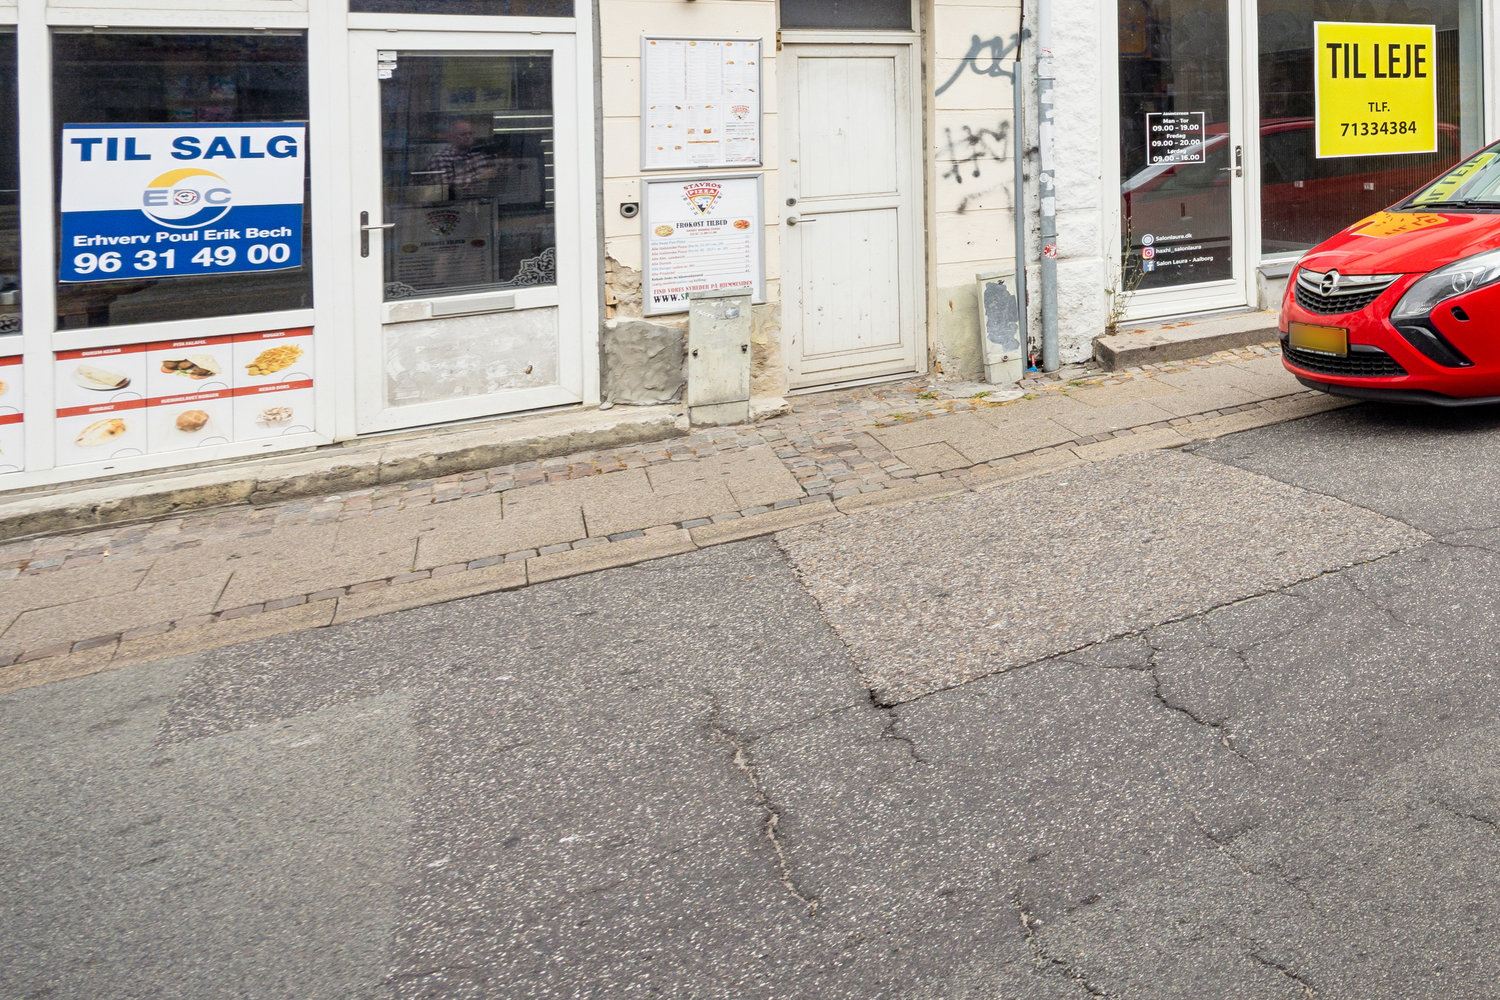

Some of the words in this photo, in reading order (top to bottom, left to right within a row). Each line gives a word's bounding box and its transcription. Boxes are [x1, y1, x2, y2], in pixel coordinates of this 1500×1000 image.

[1326, 43, 1366, 78] TIL
[1374, 43, 1427, 78] LEJE
[1368, 102, 1390, 112] TLF.
[1340, 121, 1417, 136] 71334384
[71, 137, 151, 162] TIL
[171, 135, 298, 160] SALG
[683, 182, 723, 190] STAVROS
[143, 187, 232, 207] EDC
[676, 221, 704, 229] FROKOST
[73, 234, 150, 247] Erhverv
[156, 230, 199, 243] Poul
[204, 228, 240, 240] Erik
[245, 226, 292, 239] Bech
[73, 251, 122, 274] 96
[133, 248, 175, 271] 31
[191, 245, 236, 267] 49
[247, 243, 290, 264] 00
